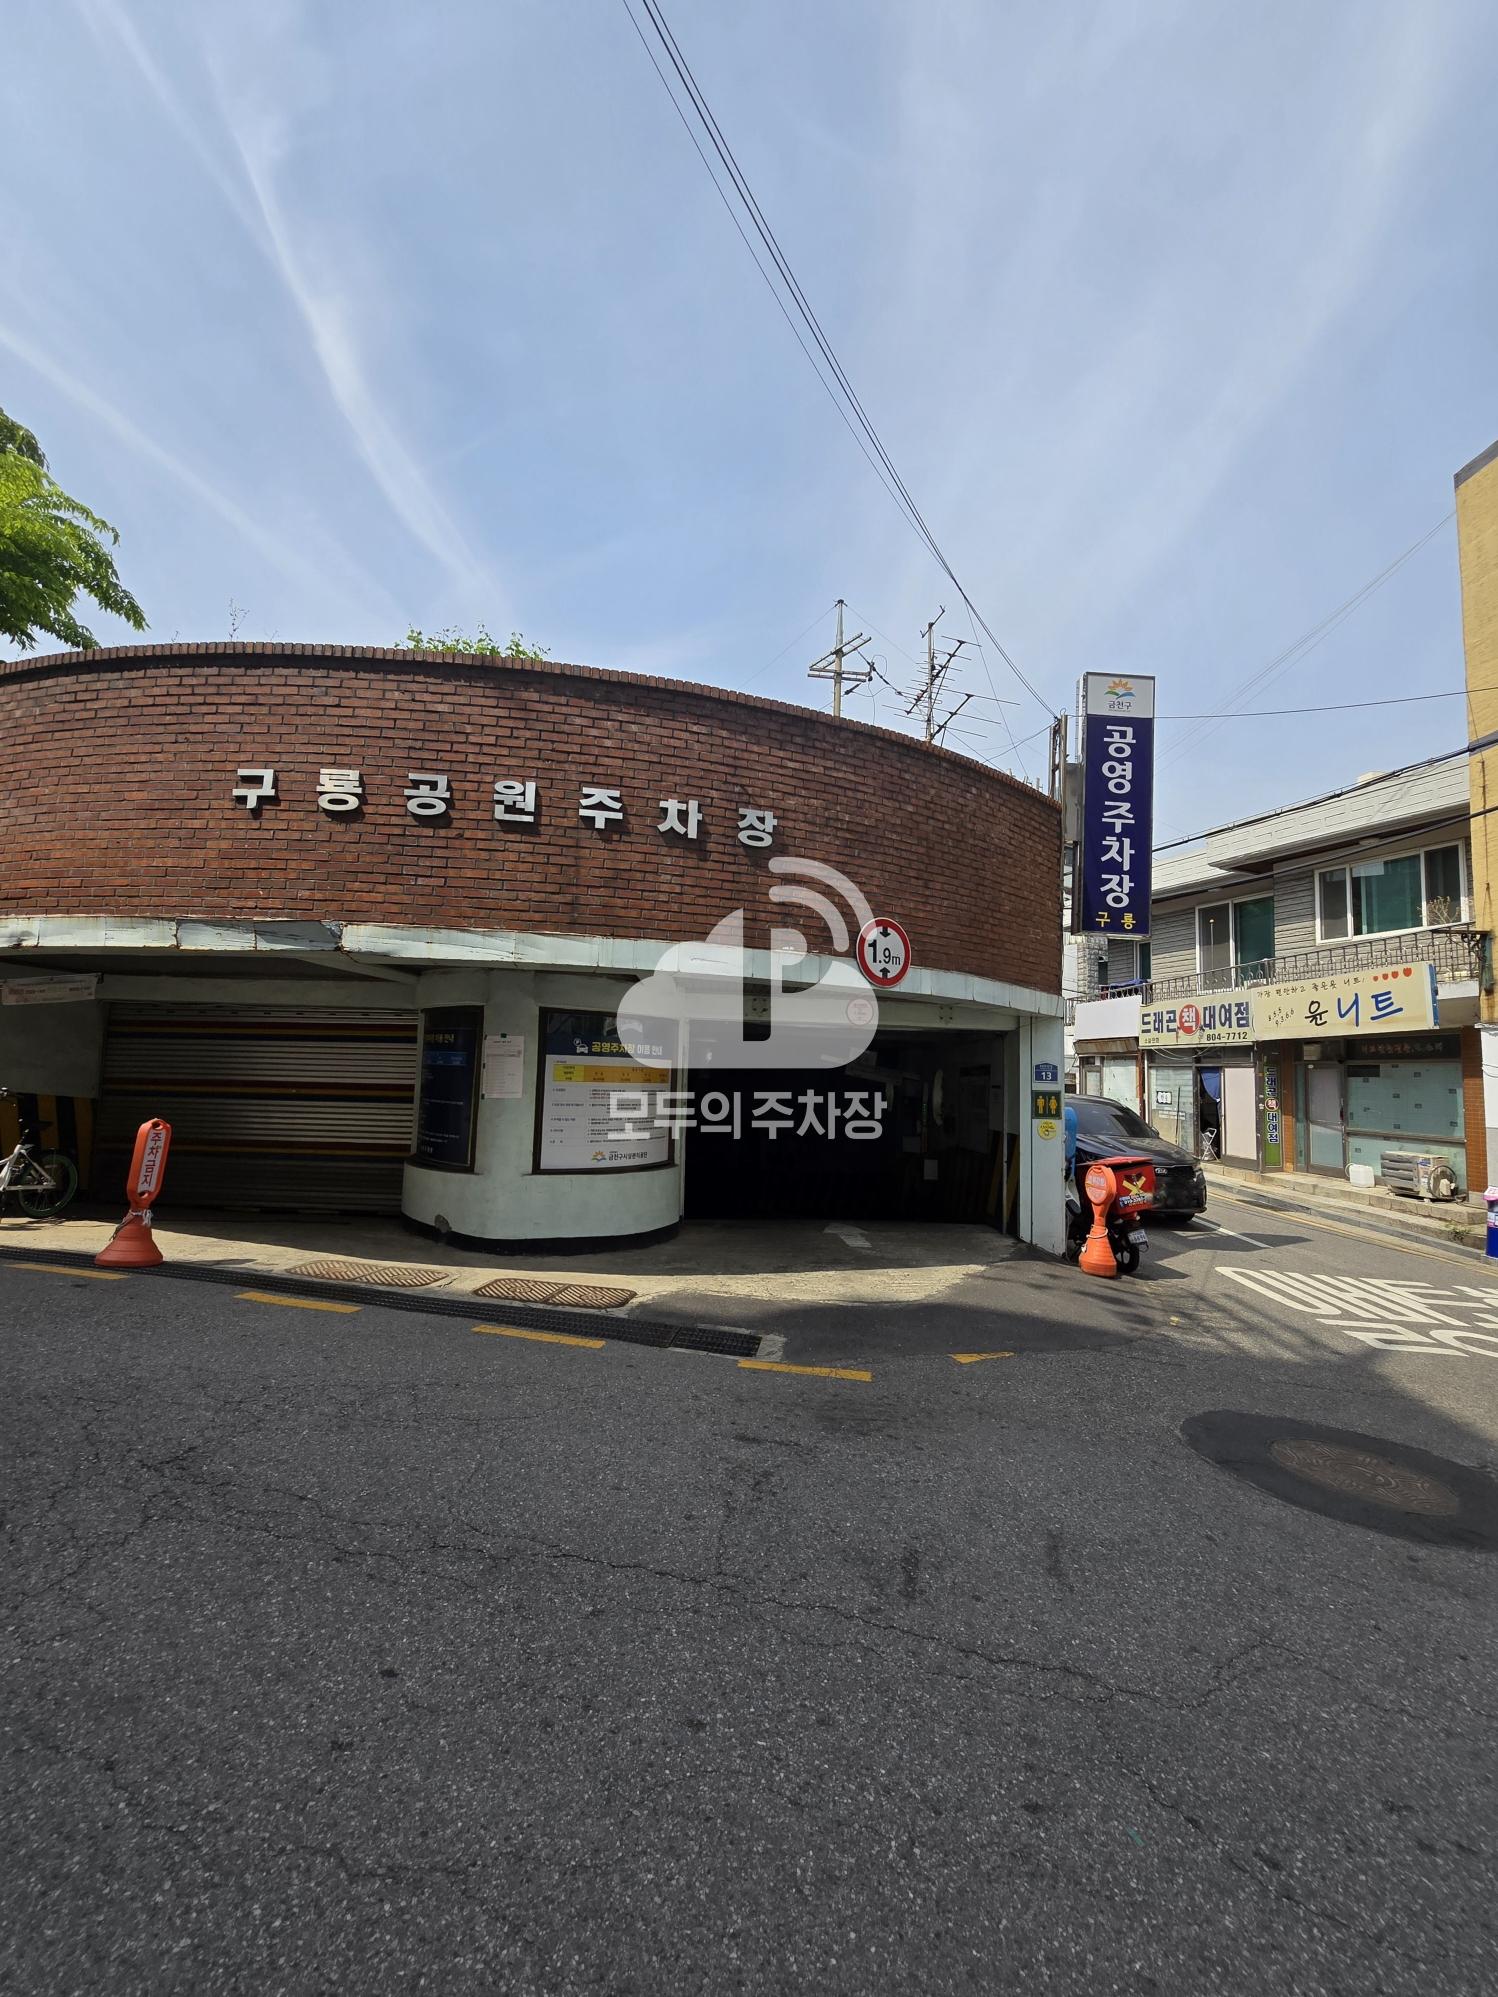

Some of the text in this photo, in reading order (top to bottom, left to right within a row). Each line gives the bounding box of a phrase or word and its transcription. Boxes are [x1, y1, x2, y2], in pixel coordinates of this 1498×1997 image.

[1108, 701, 1132, 710] 금천구
[1100, 725, 1136, 908] 공영주차장
[1096, 912, 1136, 930] 구룡
[868, 939, 901, 966] 1.9m
[1141, 1009, 1177, 1034] 드래곤
[1203, 1001, 1250, 1030] 대여점
[591, 1041, 635, 1055] 공영주차장
[1206, 1031, 1248, 1043] 804-7712
[1041, 1071, 1052, 1081] 13
[1267, 1111, 1280, 1144] 대여점
[141, 1132, 162, 1187] 주차금지
